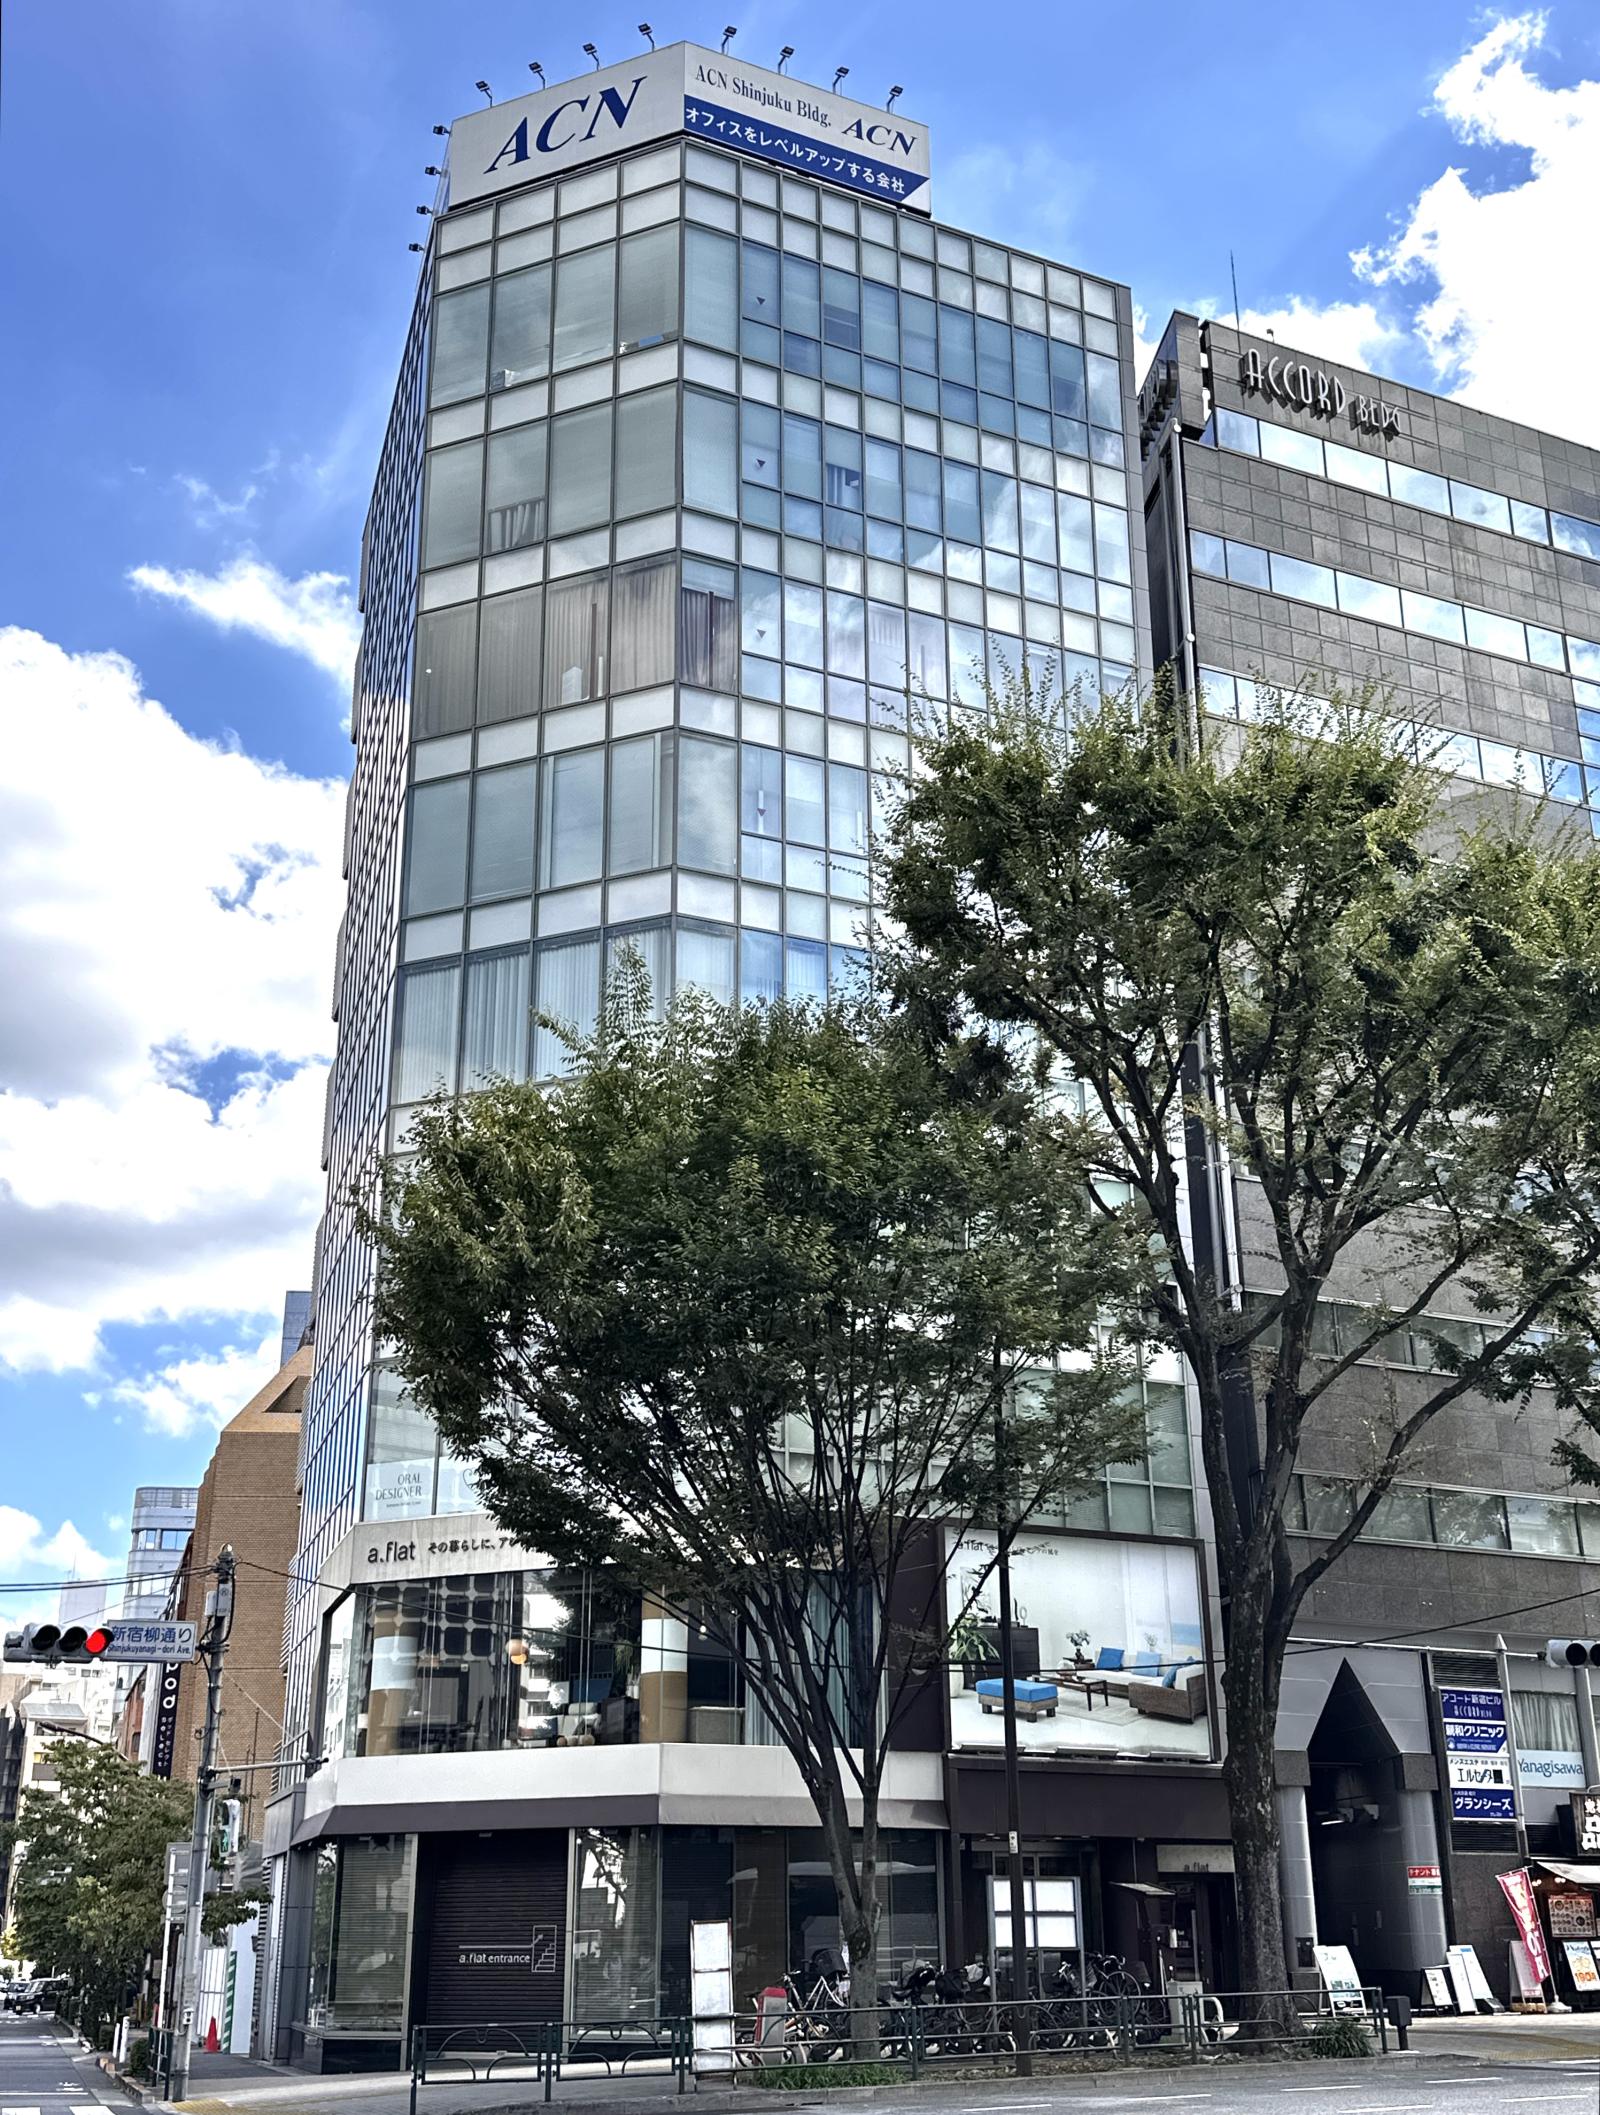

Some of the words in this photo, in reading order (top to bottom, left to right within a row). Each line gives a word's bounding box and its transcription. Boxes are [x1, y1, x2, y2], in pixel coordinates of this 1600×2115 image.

[696, 65, 728, 90] ACN
[732, 77, 793, 113] Shinjuku
[797, 99, 832, 127] Bldg.
[483, 75, 648, 174] ACN
[842, 118, 918, 156] ACN
[686, 107, 905, 195] オフィスをレベルアップする会社
[1247, 349, 1346, 413] ACCORD
[1357, 395, 1400, 430] BLDG
[397, 1472, 422, 1485] ORAL
[375, 1486, 422, 1501] DESIGNER
[367, 1541, 416, 1563] a.flat
[112, 1626, 192, 1643] 新宿柳通り
[1441, 1693, 1502, 1705] アコード新宿ビル
[1518, 1758, 1584, 1778] Yanagisawa
[1454, 1796, 1513, 1811] グランシーズ
[459, 1953, 486, 1963] a.flat
[488, 1954, 530, 1963] entrance
